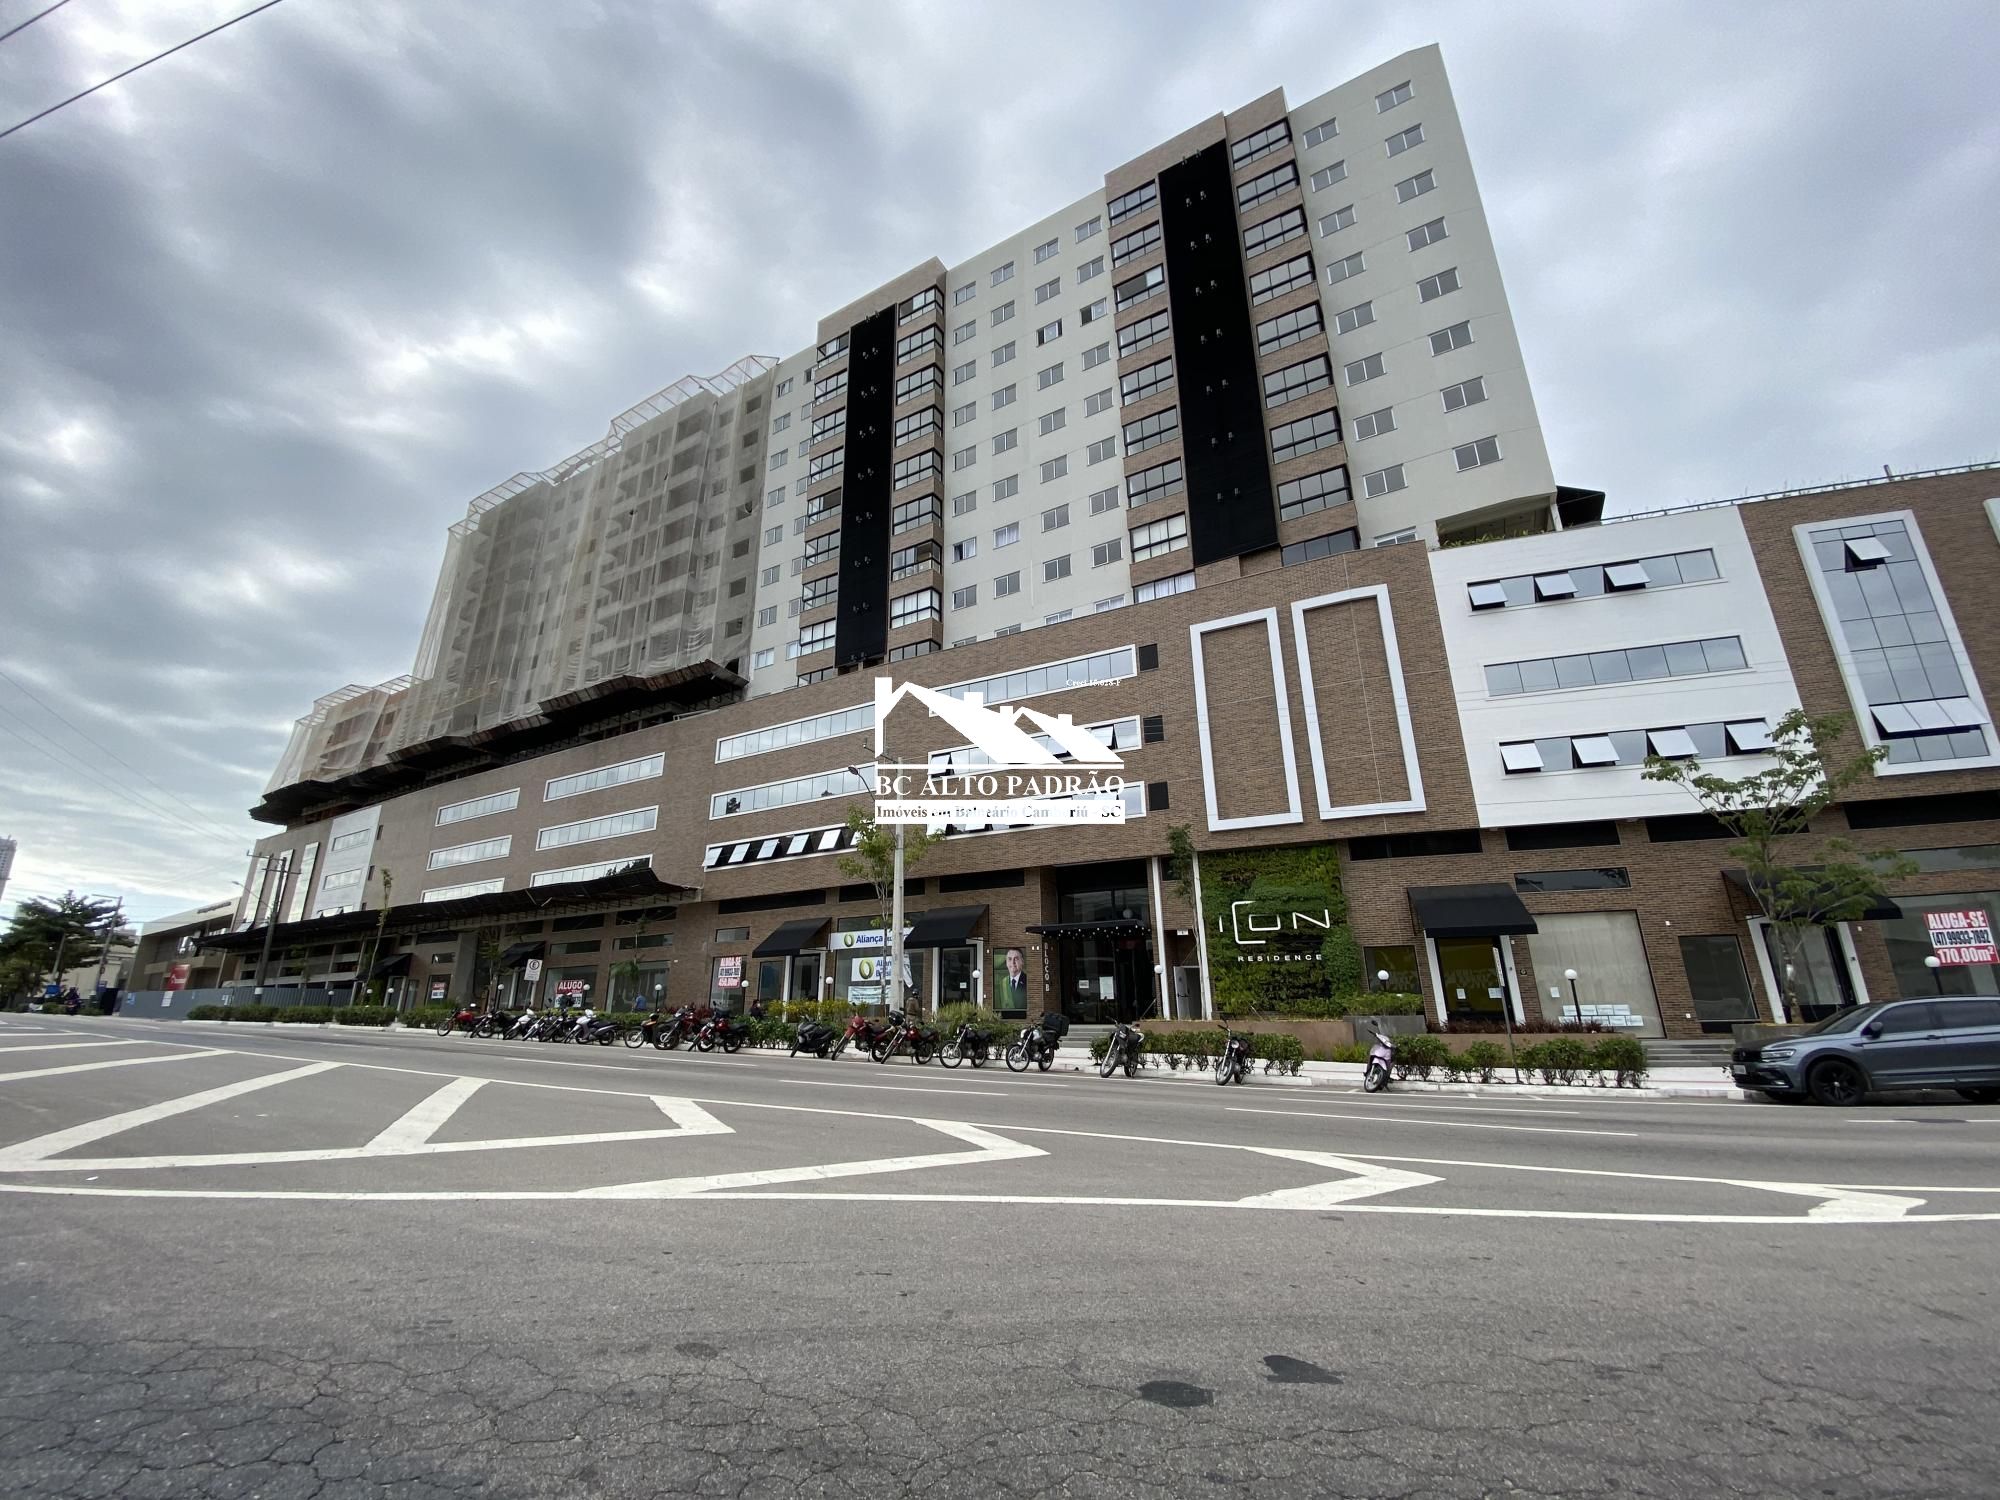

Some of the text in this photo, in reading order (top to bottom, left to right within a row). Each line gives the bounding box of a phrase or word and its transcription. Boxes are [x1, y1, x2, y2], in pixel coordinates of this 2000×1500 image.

[1927, 911, 1985, 929] ALUGA-SE
[856, 935, 883, 944] Aliança
[1237, 954, 1322, 962] RESIDENCE
[559, 981, 583, 990] ALUGO
